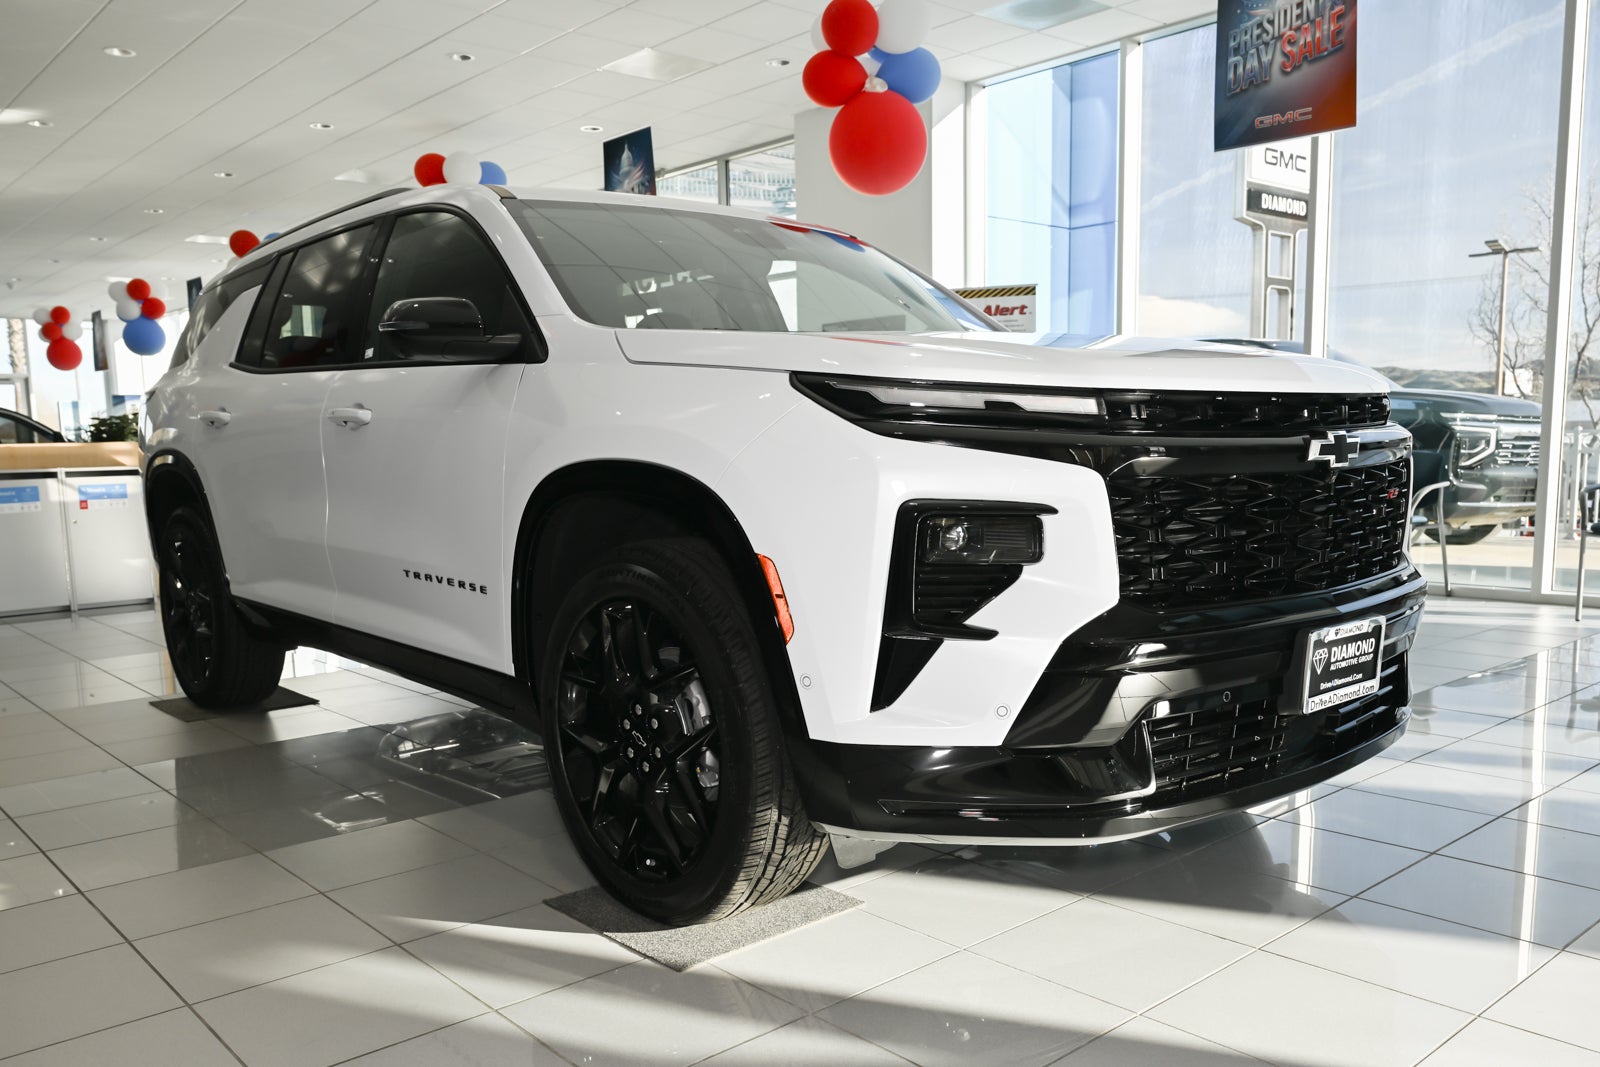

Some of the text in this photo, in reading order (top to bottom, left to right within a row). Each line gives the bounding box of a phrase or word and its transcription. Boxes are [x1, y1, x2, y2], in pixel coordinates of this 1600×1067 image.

[1227, 5, 1345, 96] DAY SALE
[1255, 107, 1312, 129] GMC
[1264, 147, 1307, 173] GMC
[1261, 192, 1307, 217] DIAMOND
[983, 303, 1028, 316] Alert
[402, 569, 488, 595] TRAVERSE
[1339, 623, 1364, 637] DIAMOND
[1329, 653, 1374, 671] AUTOMOTIVE GROUP
[1330, 638, 1375, 663] DIAMOND
